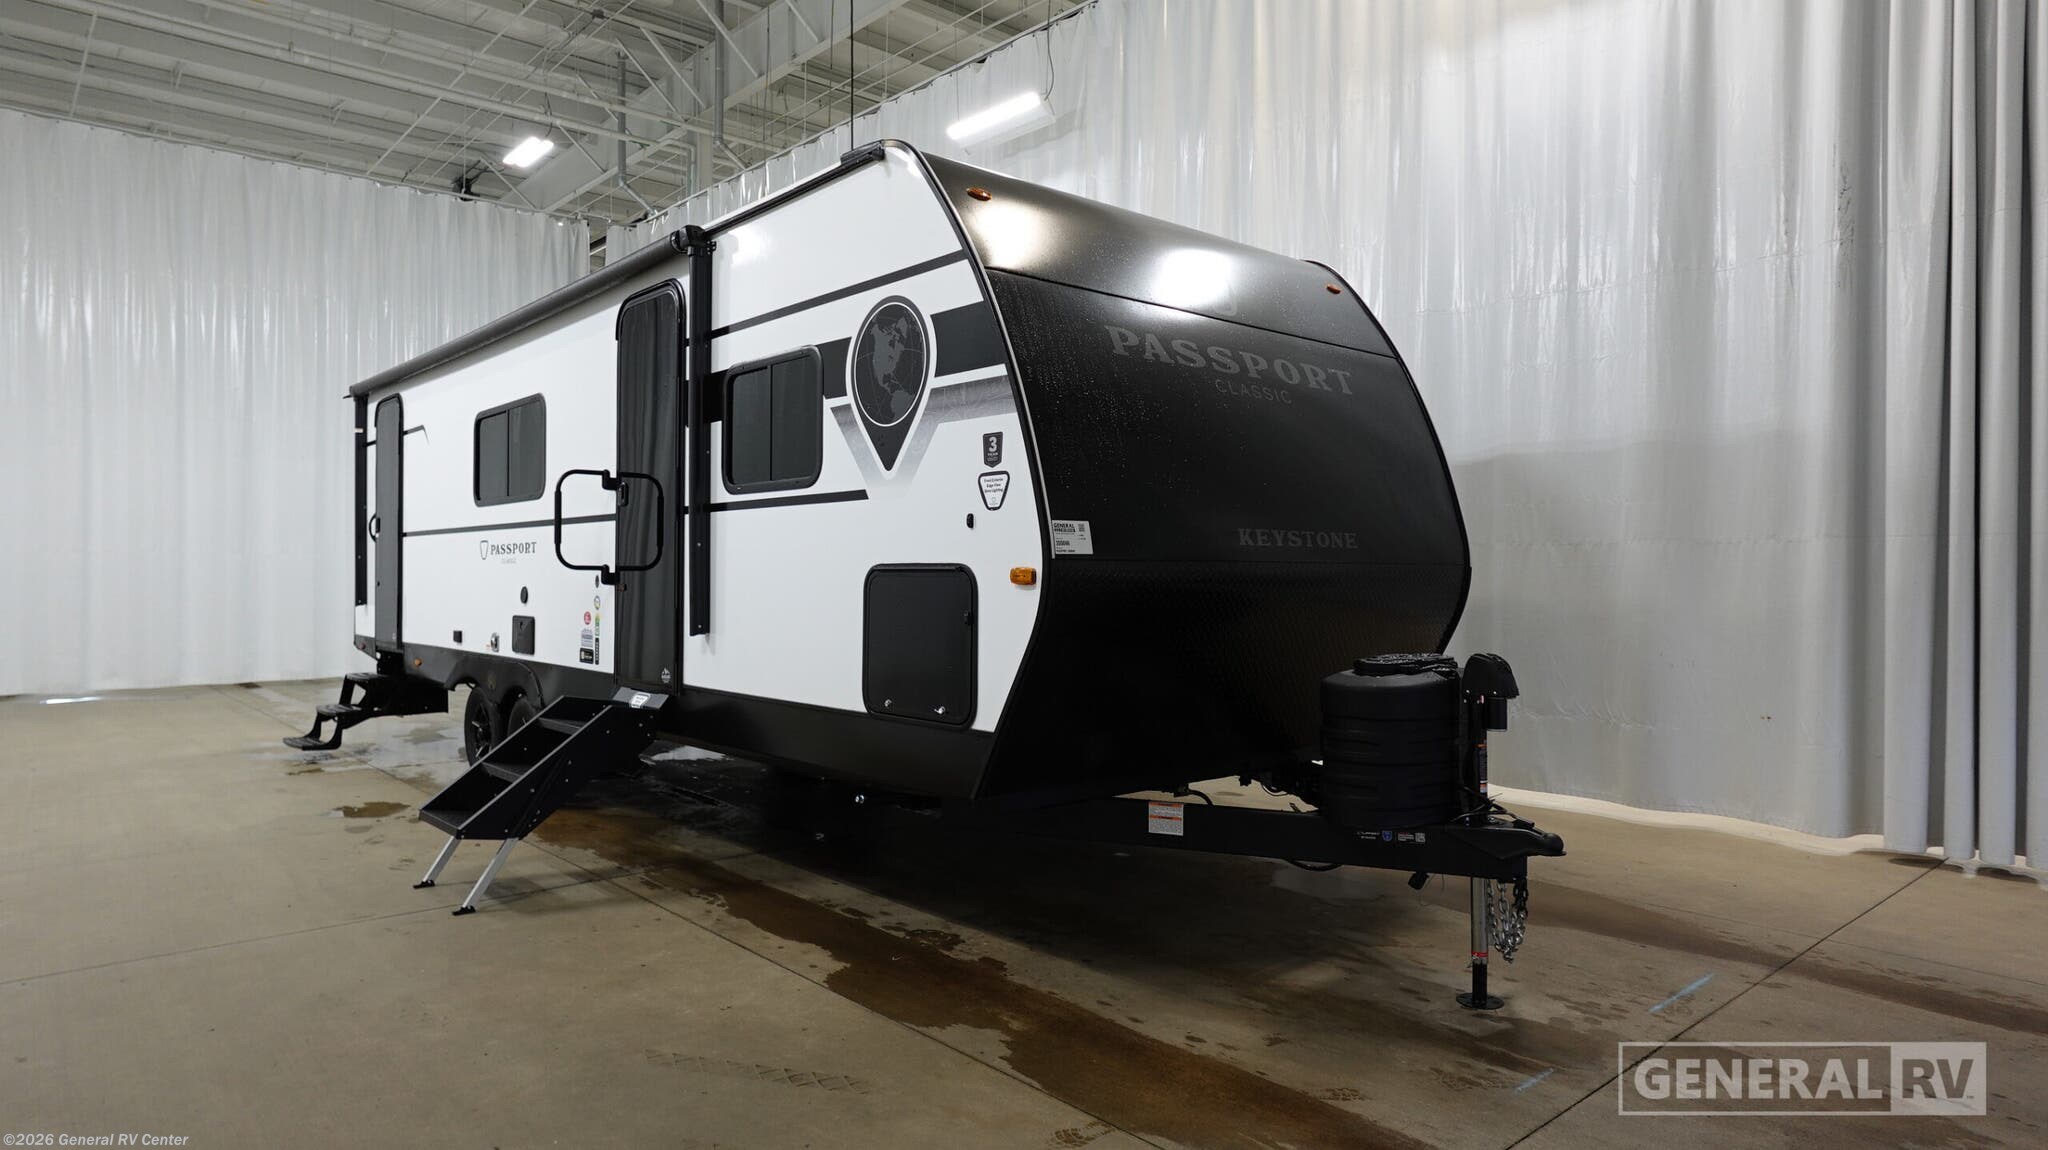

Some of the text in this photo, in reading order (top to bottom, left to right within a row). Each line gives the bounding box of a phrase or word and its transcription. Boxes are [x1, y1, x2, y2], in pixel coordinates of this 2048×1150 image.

[1104, 325, 1353, 395] PASSPORT
[1215, 379, 1292, 404] CLASSIC
[989, 436, 998, 452] 3
[490, 541, 537, 555] PASSPORT
[1238, 528, 1359, 549] KEYSTONE
